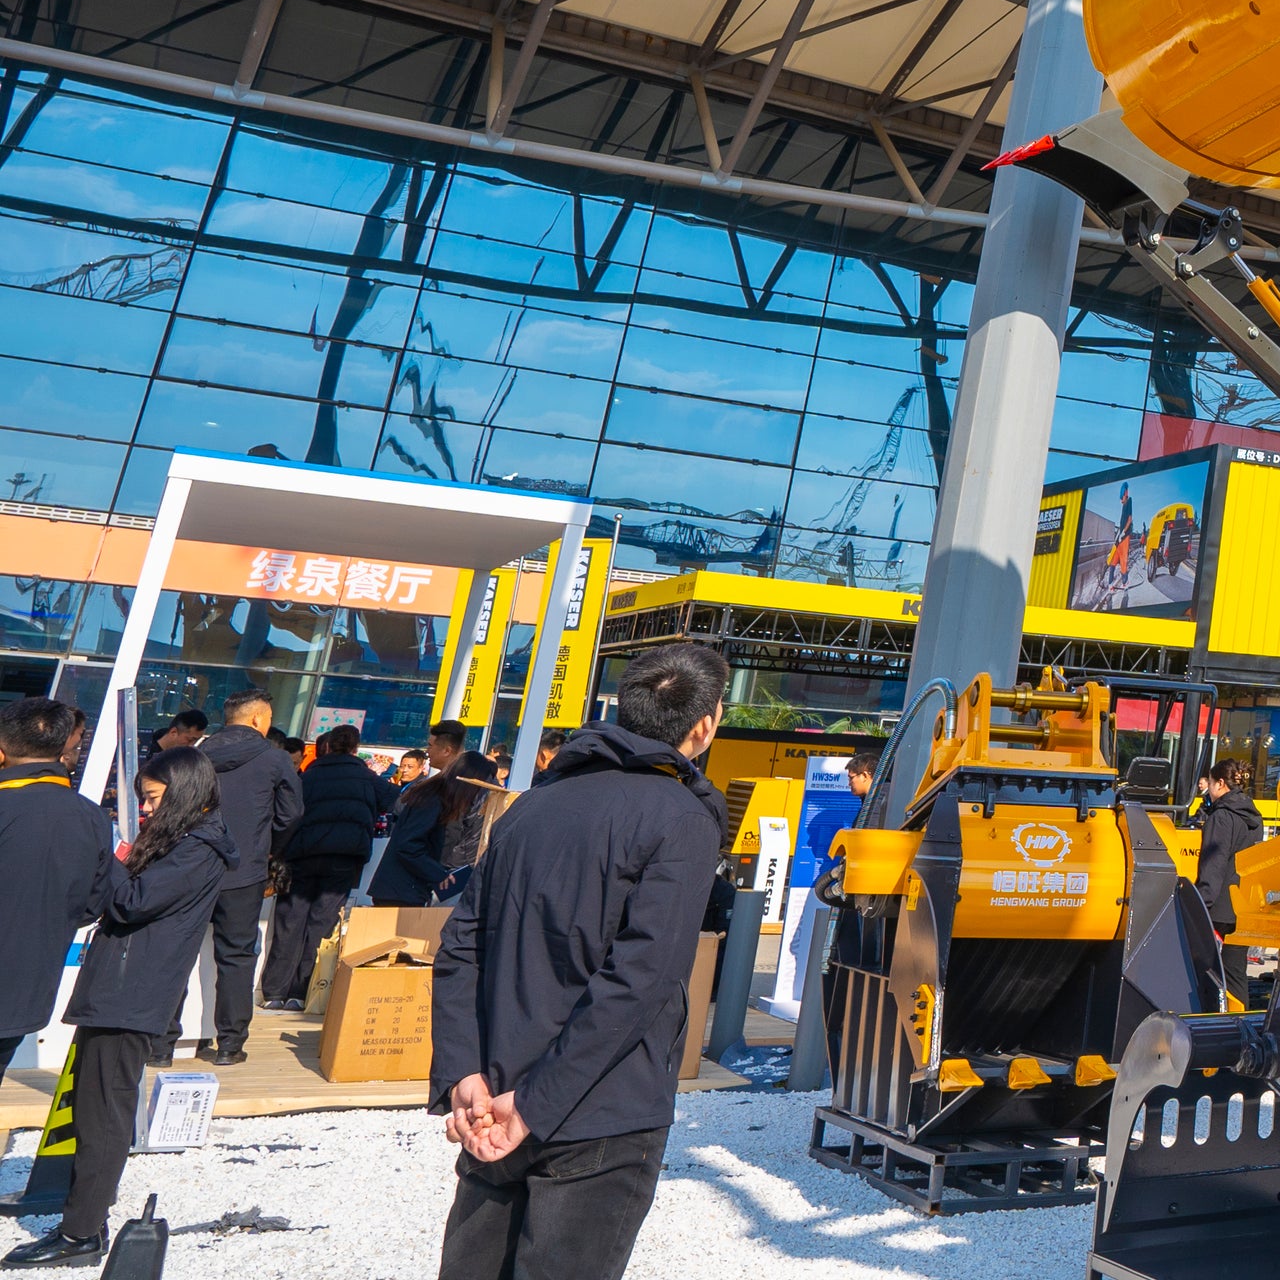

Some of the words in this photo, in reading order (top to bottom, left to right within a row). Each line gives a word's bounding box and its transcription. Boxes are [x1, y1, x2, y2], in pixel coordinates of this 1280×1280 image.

[1038, 508, 1063, 522] AESER
[246, 550, 433, 604] 绿泉餐厅
[1025, 834, 1060, 850] HW
[762, 857, 778, 917] KAESER
[993, 871, 1089, 894] 恒旺集团
[990, 896, 1049, 908] HENGWANG
[1052, 897, 1087, 908] GROUP
